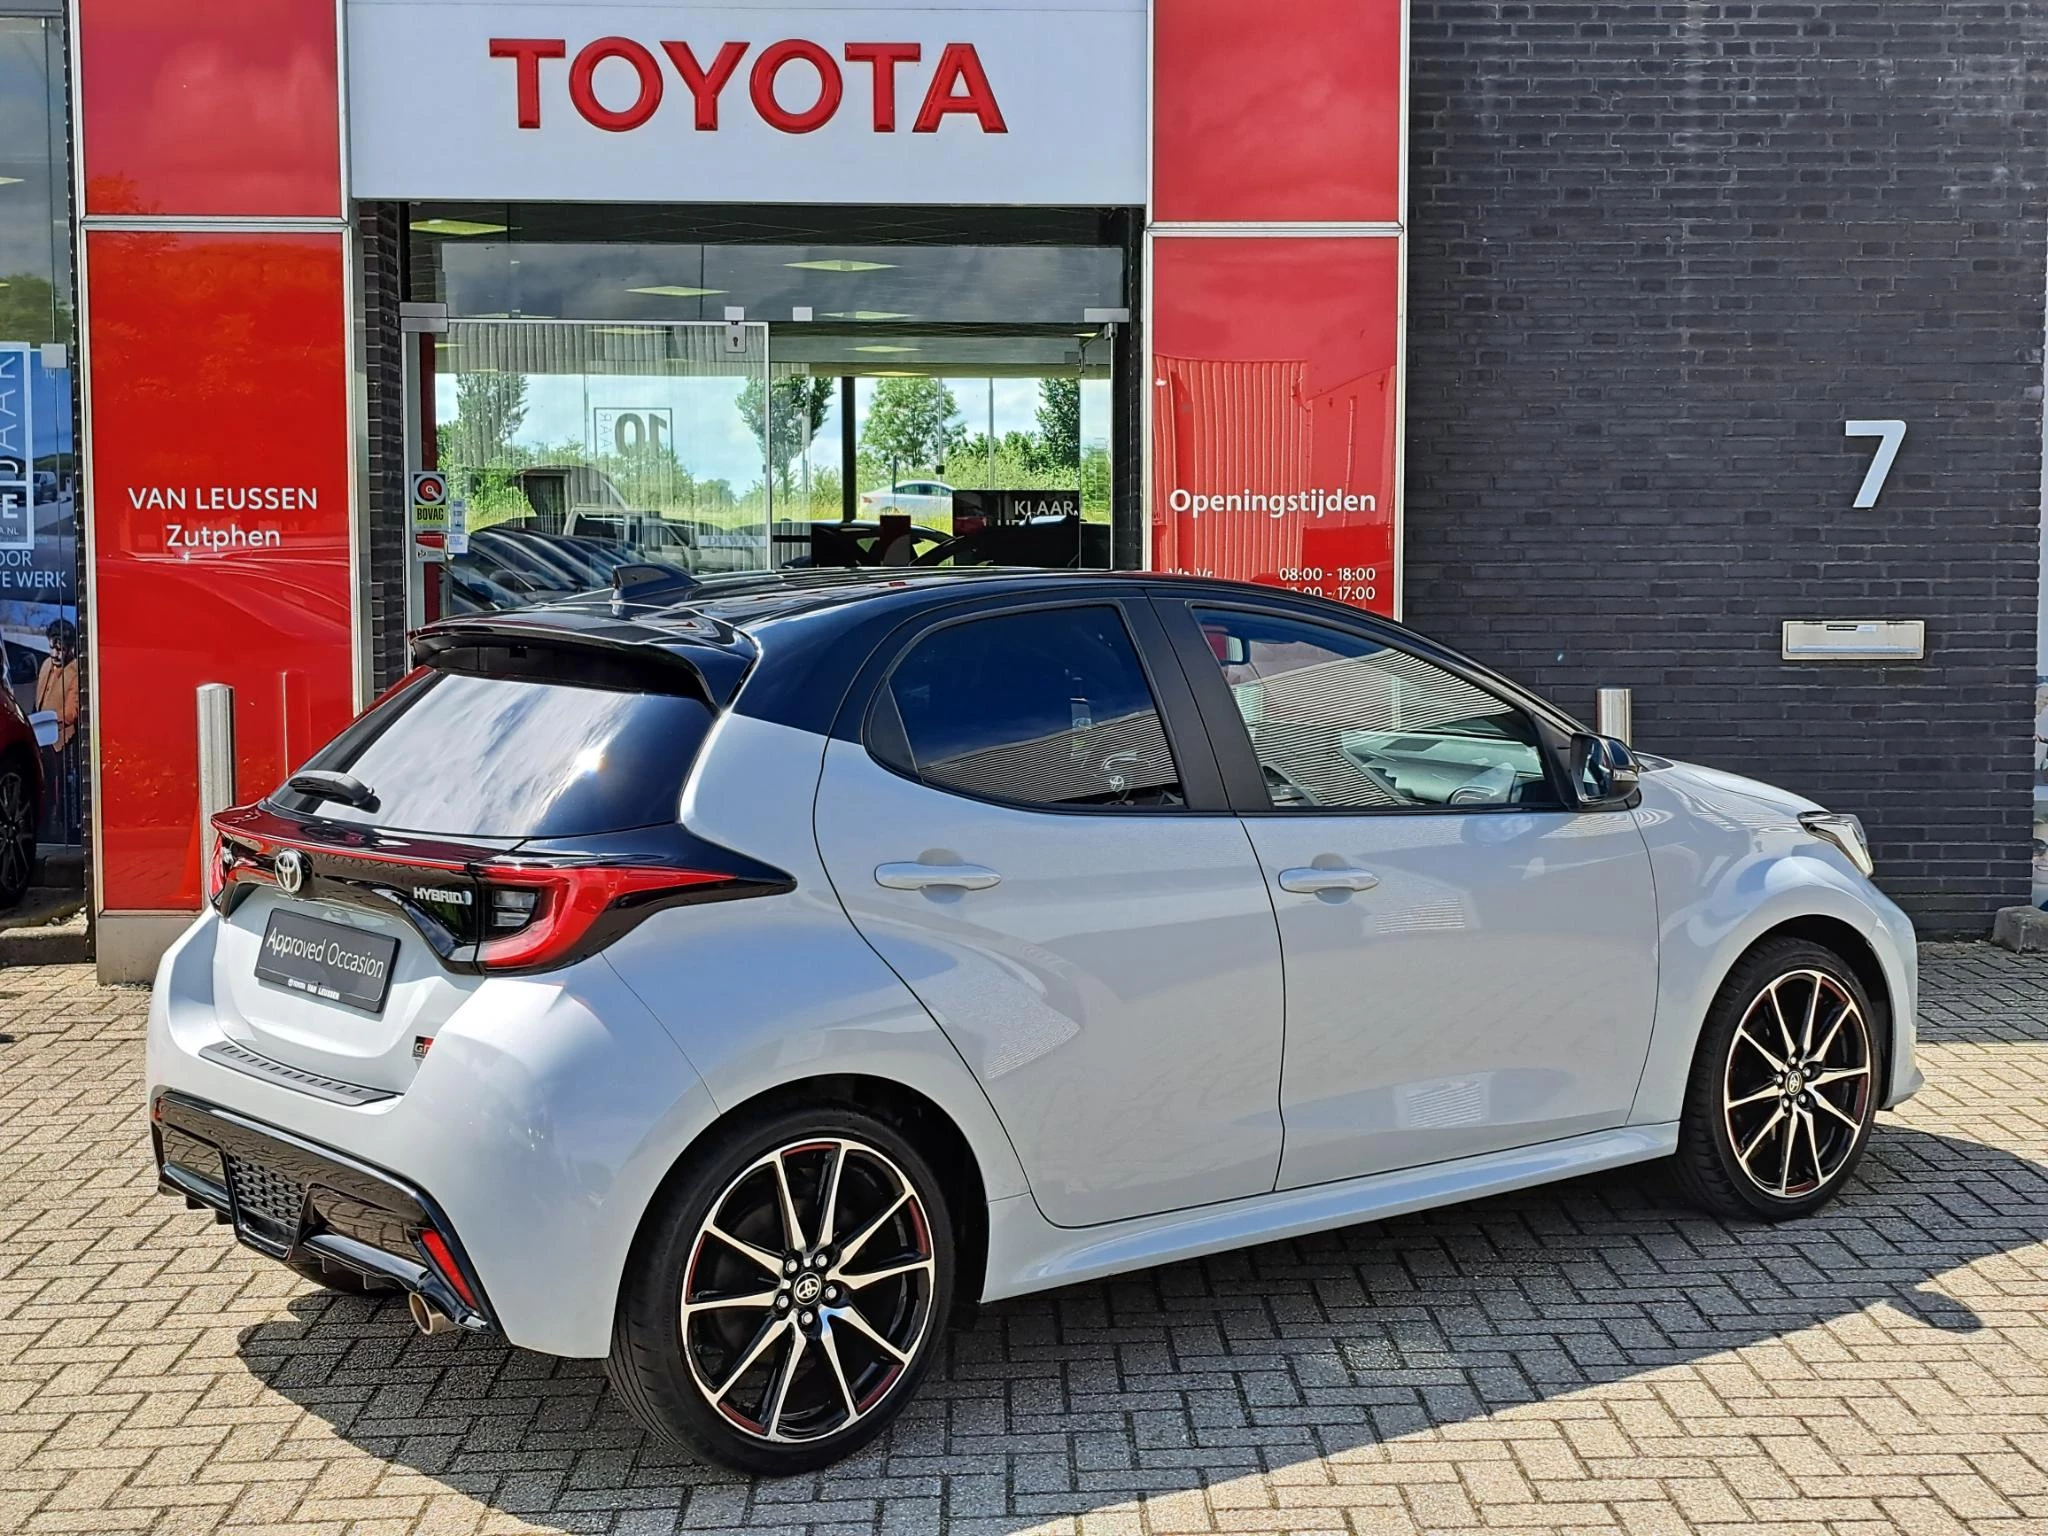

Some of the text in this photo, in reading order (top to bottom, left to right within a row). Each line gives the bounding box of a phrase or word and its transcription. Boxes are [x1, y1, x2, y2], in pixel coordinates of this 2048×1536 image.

[489, 36, 1008, 134] TOYOTA
[1845, 420, 1907, 508] 7
[128, 487, 318, 510] VAN LEUSSEN
[1169, 489, 1376, 518] Openingstijden
[416, 508, 444, 520] BOVAG
[166, 524, 280, 551] Zutphen
[15, 570, 67, 588] WERK
[1279, 568, 1322, 581] 08:00
[1337, 568, 1375, 581] 18:00
[1337, 586, 1375, 600] 17:00
[413, 887, 464, 905] HYBRID
[266, 927, 384, 978] Approved Occasion
